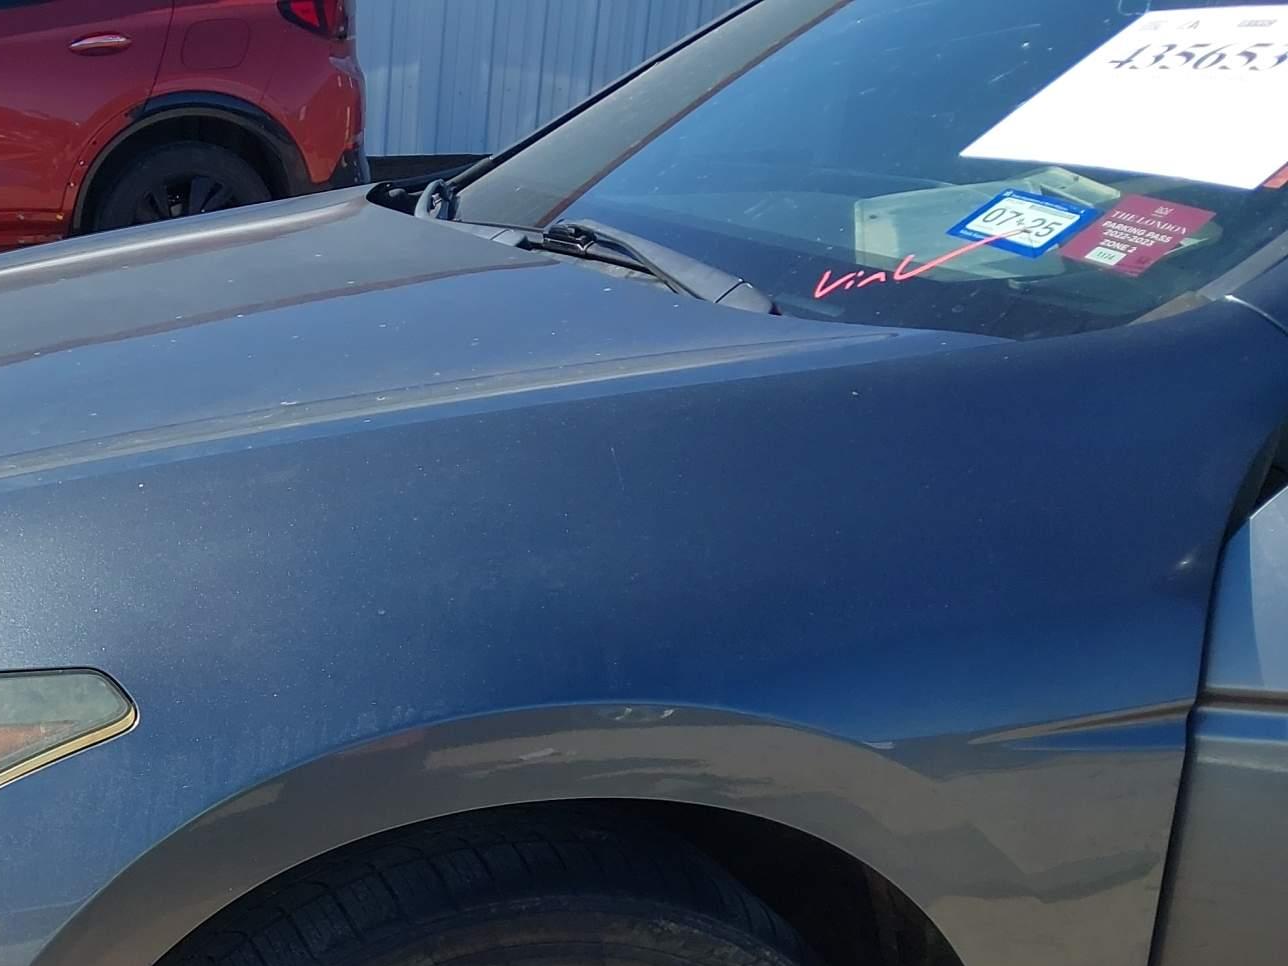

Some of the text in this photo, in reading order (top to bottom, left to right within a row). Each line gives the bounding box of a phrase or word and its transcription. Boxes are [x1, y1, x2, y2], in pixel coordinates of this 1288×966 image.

[1102, 221, 1173, 243] PARKING PASS
[1112, 210, 1188, 235] THE LONDON
[1099, 238, 1128, 251] ZONE
